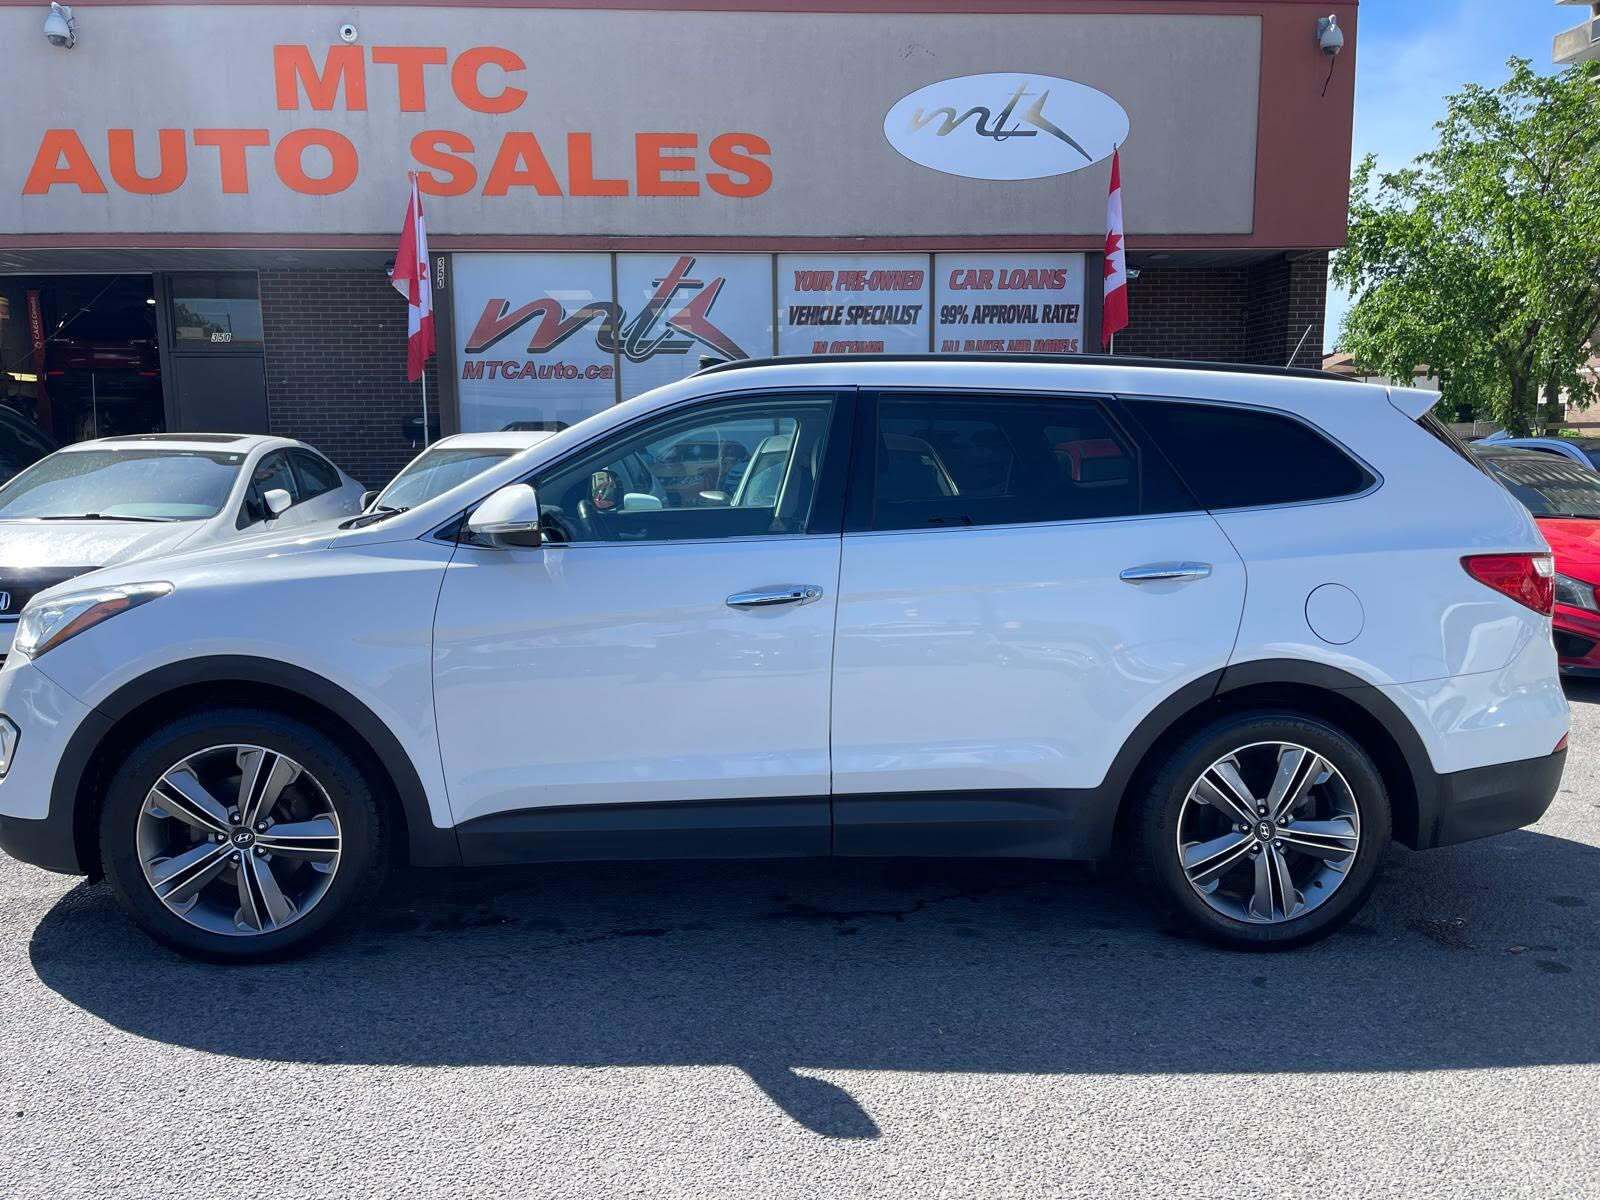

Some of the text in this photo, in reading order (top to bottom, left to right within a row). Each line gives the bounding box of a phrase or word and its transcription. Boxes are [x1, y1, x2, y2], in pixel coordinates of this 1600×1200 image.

[273, 45, 528, 114] MTC
[22, 129, 773, 197] AUTO SALES
[437, 257, 445, 288] 350
[794, 271, 924, 291] YOUR PRE-OWNED
[949, 269, 1067, 290] CAR LOANS
[789, 304, 922, 325] VEHICLE SPECIALIST
[940, 304, 1080, 324] 99% APPROVAL RATE!
[210, 332, 231, 342] 350
[462, 360, 614, 380] MTCAuto.ca
